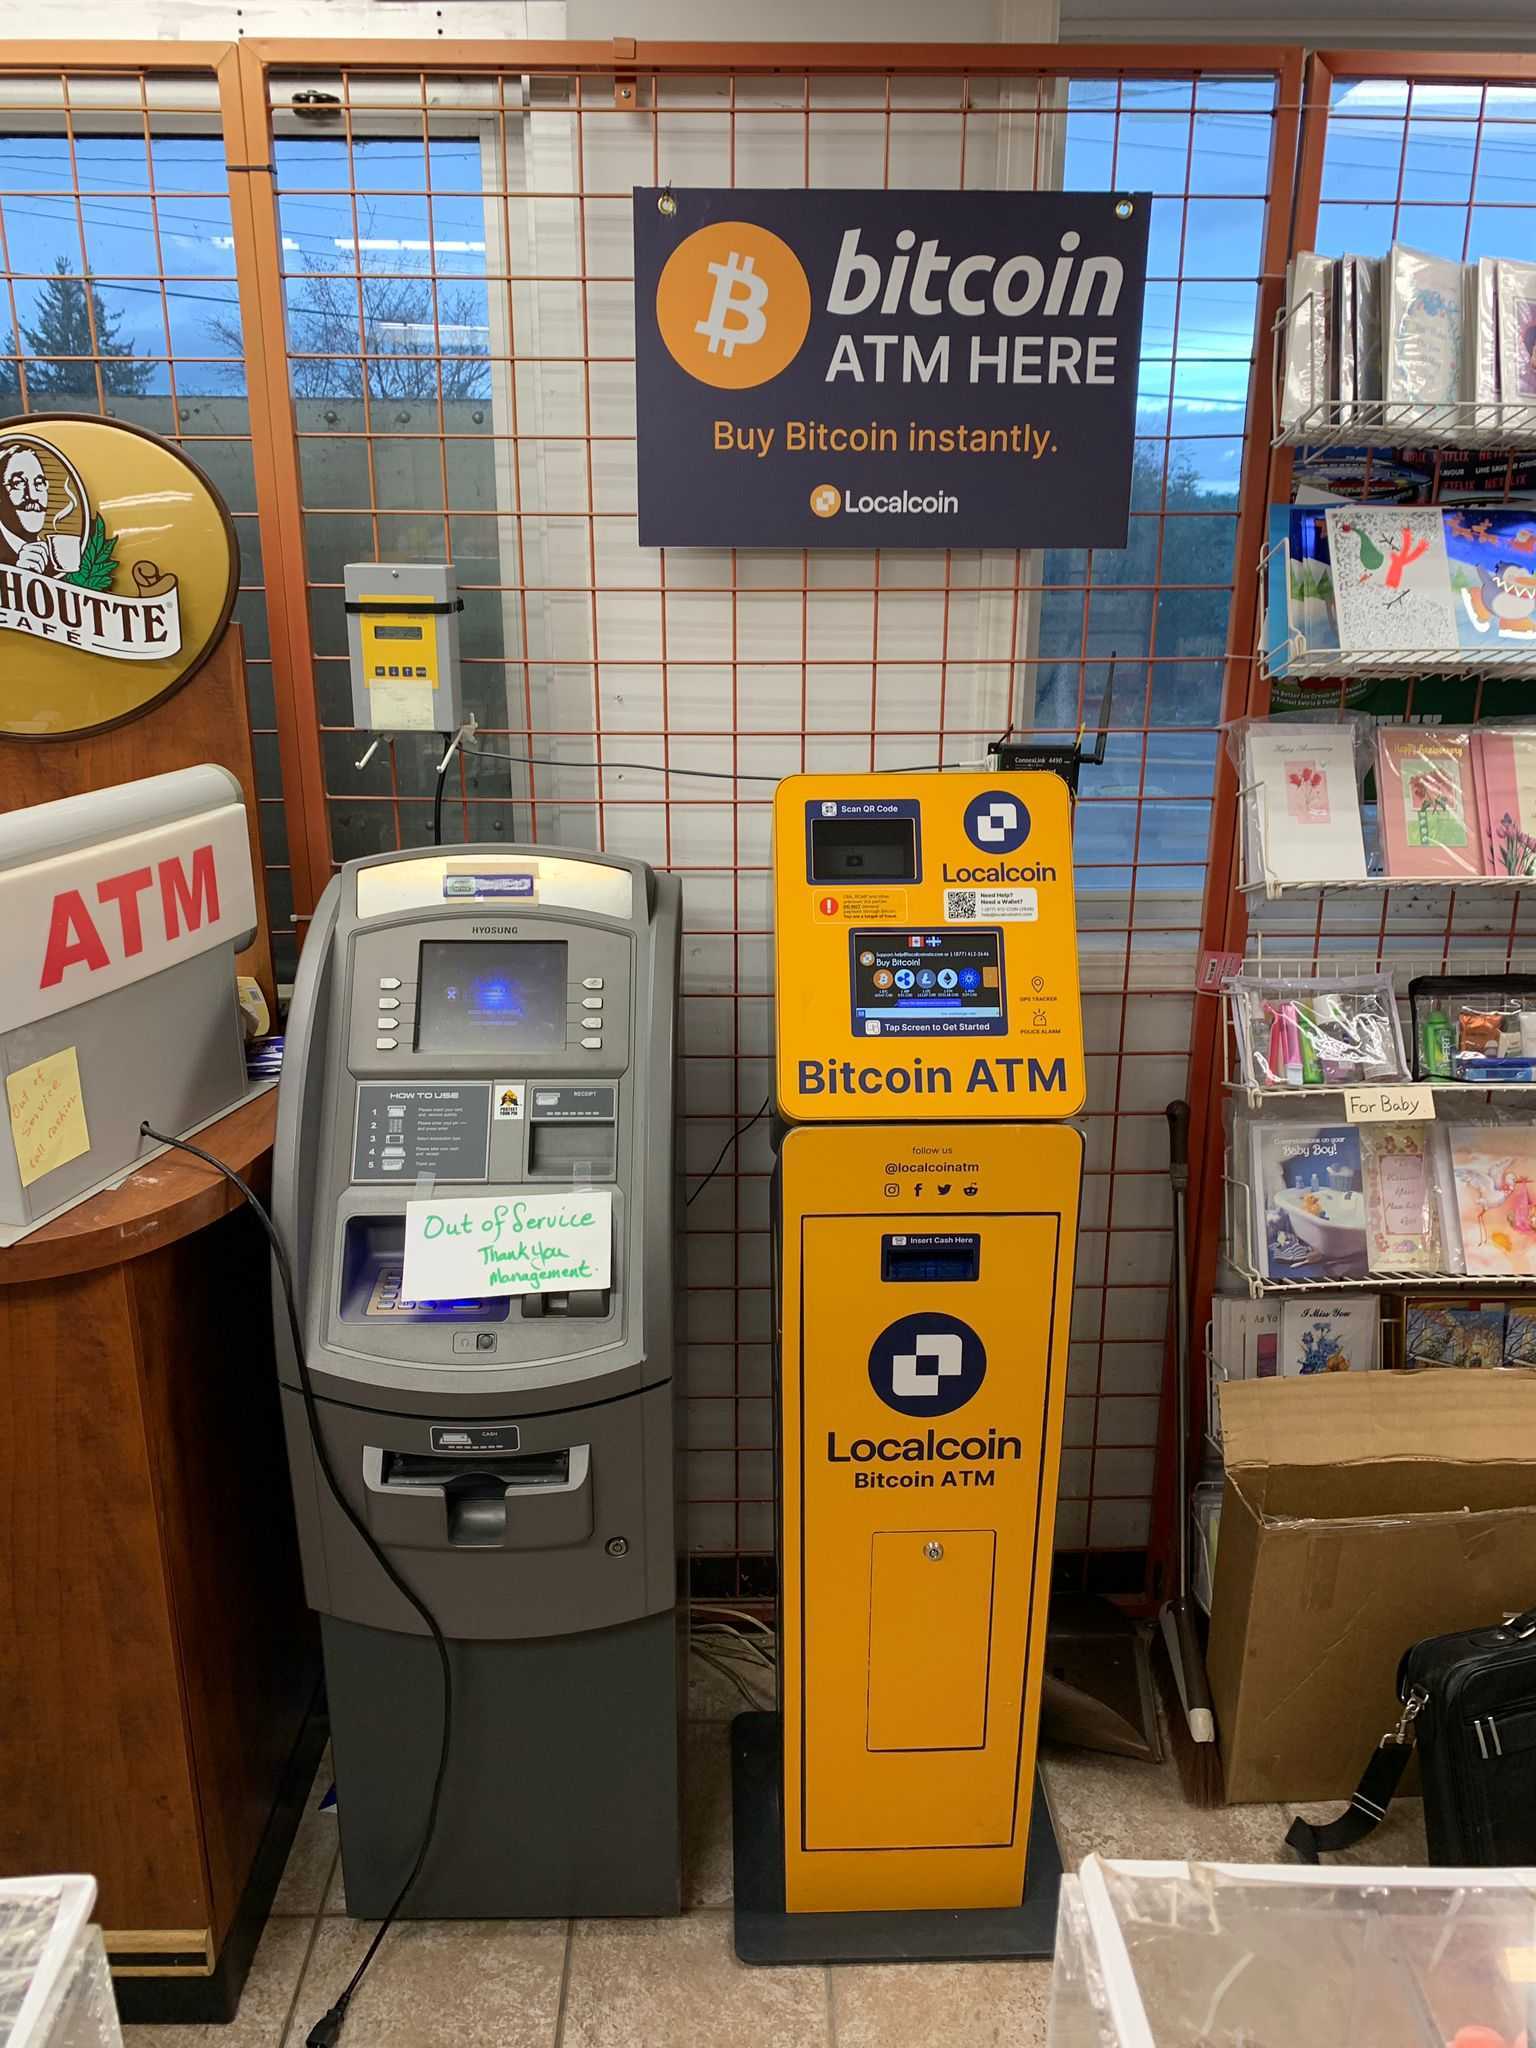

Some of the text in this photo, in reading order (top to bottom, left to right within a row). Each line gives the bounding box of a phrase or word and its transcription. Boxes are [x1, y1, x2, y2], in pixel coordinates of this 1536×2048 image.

[826, 228, 1124, 318] bitcoin
[825, 335, 1118, 385] ATM HERE
[714, 420, 1059, 460] Buy Bitcoin instantly.
[845, 489, 959, 515] Localcoin
[0, 570, 168, 643] HOUTTE
[841, 804, 898, 813] Scan QR Code
[942, 862, 1057, 883] Localcoin
[39, 845, 220, 990] ATM
[472, 926, 518, 934] HYOSUNG
[892, 958, 920, 966] Bitcoin!
[885, 1022, 990, 1032] Tap Screen to Get Started
[799, 1058, 1067, 1094] Bitcoin ATM
[1350, 1094, 1419, 1117] For Baby
[1282, 1144, 1337, 1157] Baby Boy!
[885, 1162, 979, 1175] @localcoinatm
[424, 1202, 596, 1242] Out of Service
[910, 1236, 973, 1244] Insert Cash Here
[478, 1241, 530, 1264] Thank
[1310, 1308, 1330, 1318] Miss
[1333, 1308, 1351, 1318] You
[828, 1428, 1021, 1462] Localcoin
[854, 1470, 995, 1488] Bitcoin ATM
